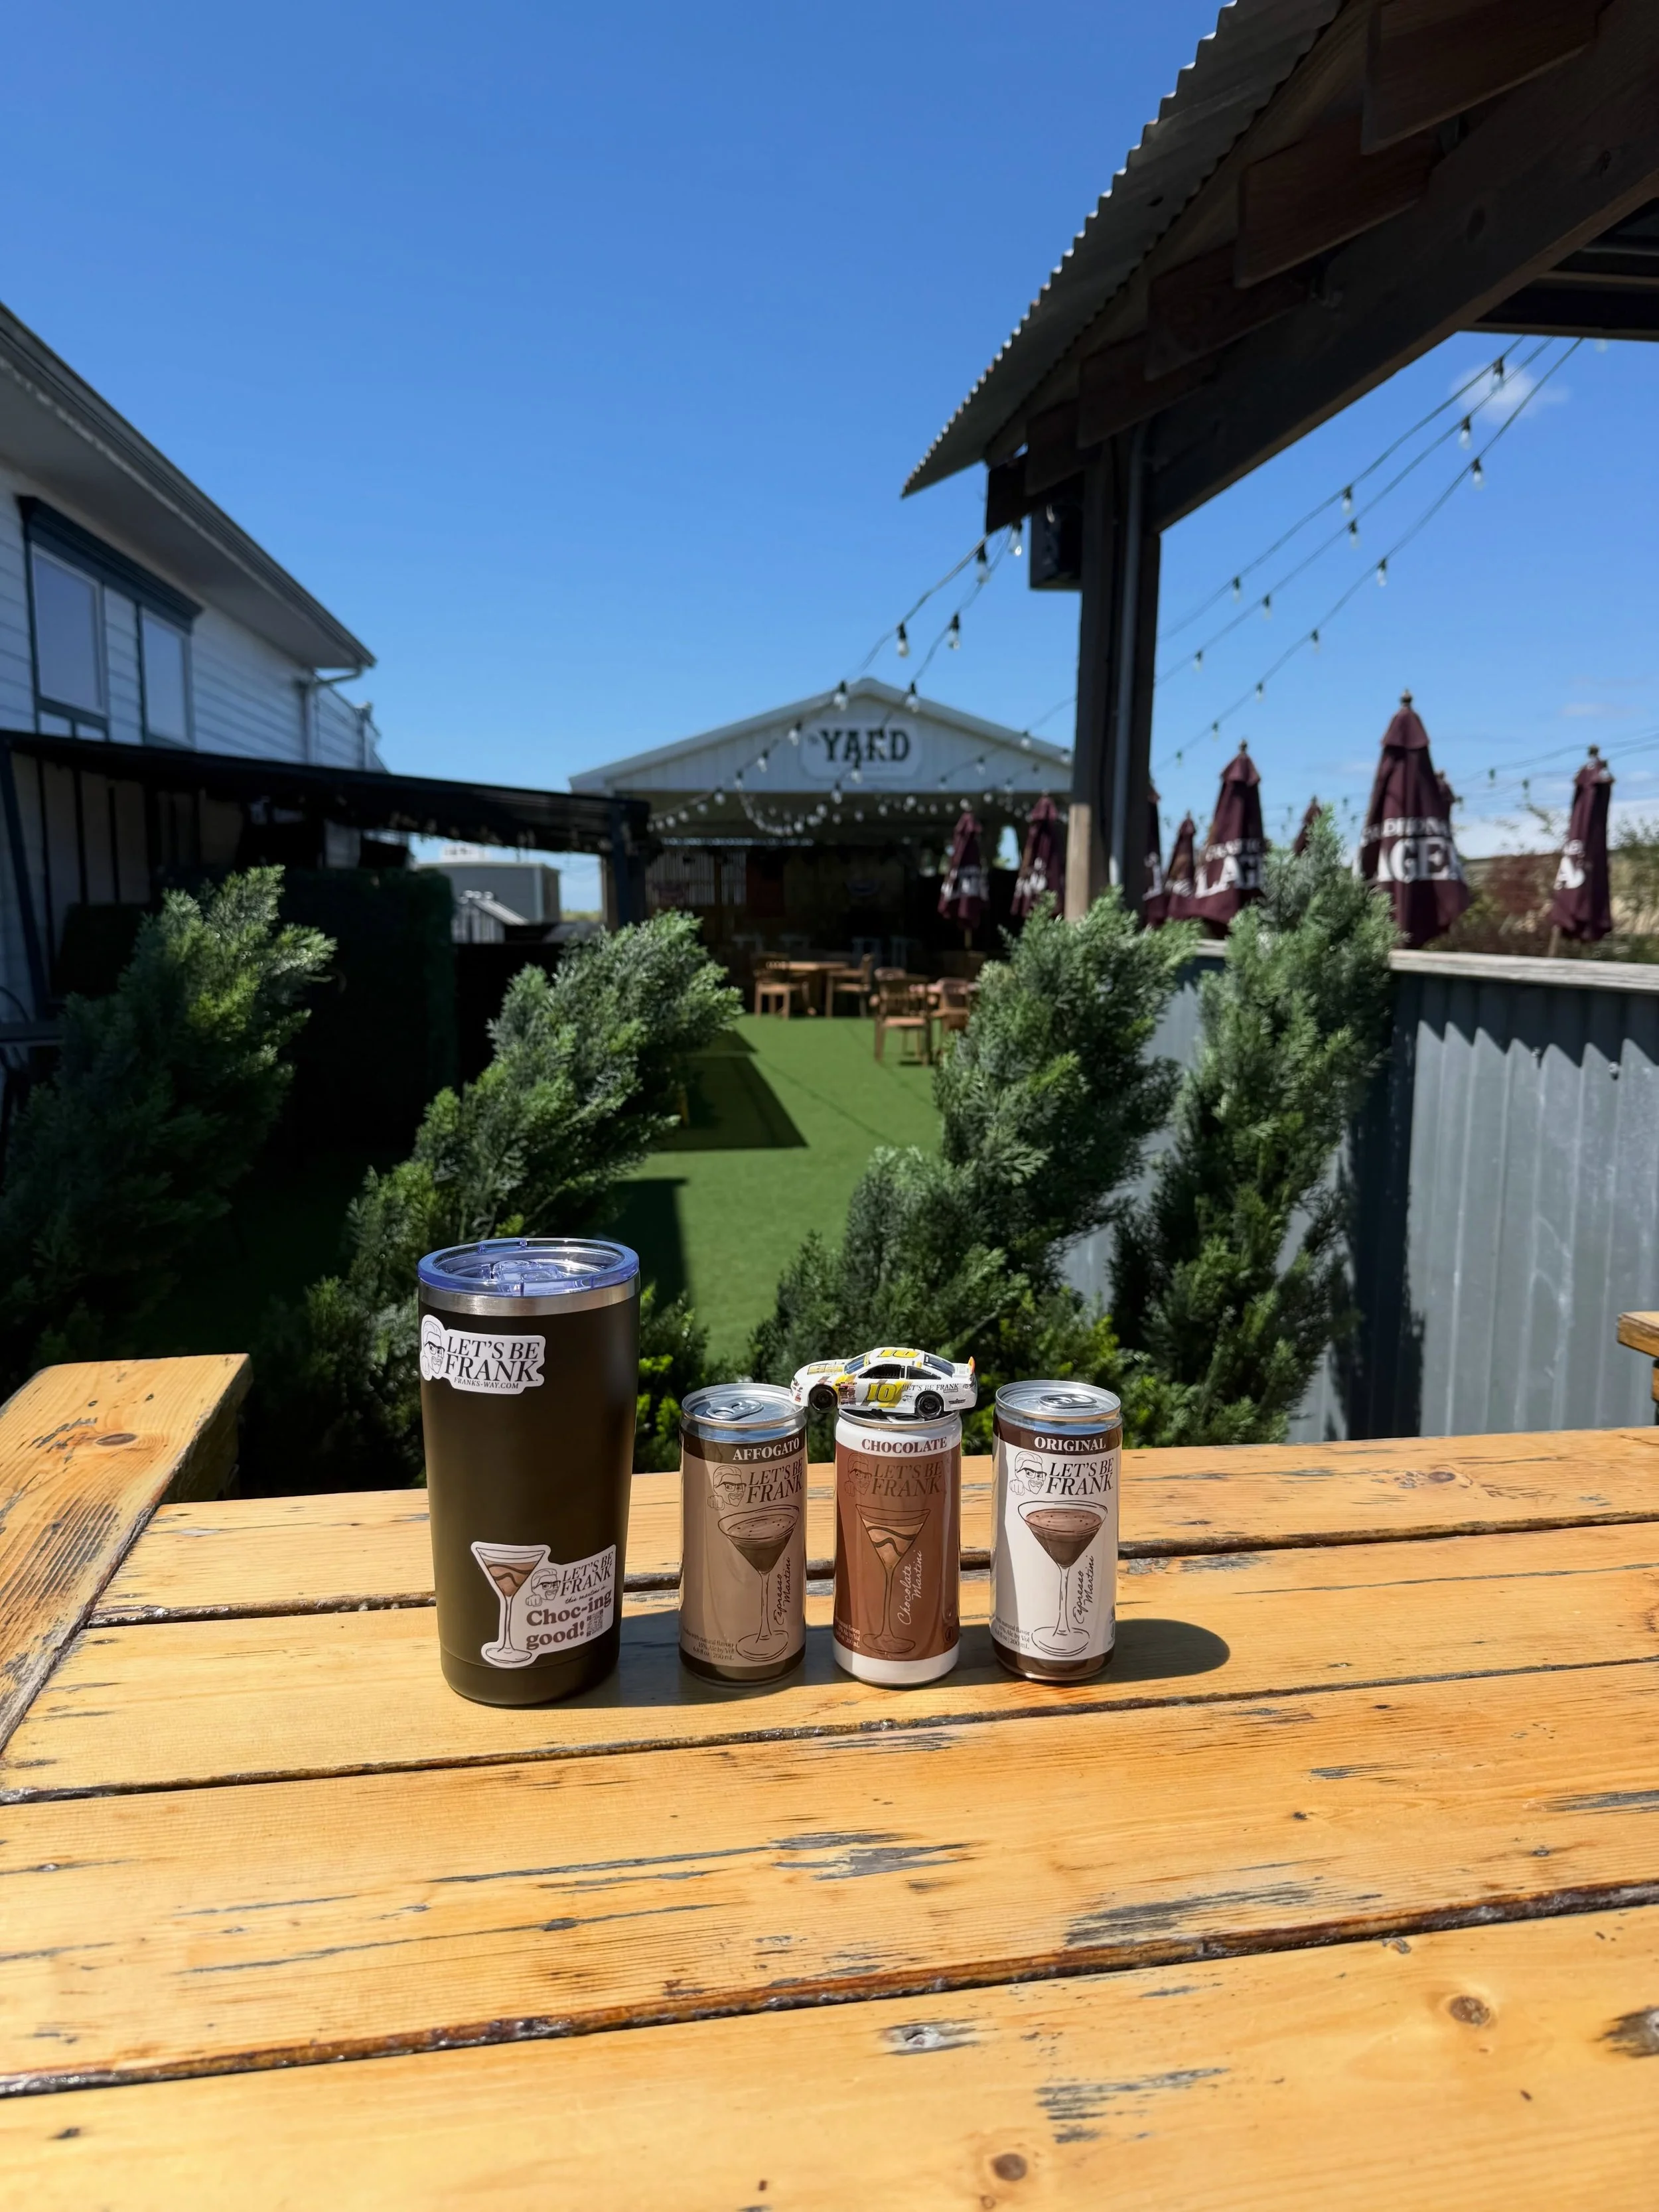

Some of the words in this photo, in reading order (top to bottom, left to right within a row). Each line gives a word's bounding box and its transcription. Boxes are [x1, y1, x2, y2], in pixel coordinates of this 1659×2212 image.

[819, 729, 910, 763] YARD
[447, 1336, 504, 1359] LET'S
[508, 1342, 540, 1360] BE
[878, 1349, 920, 1358] 10
[454, 1377, 519, 1389] FRANKS-WAY.COM
[865, 1382, 897, 1402] 10
[733, 1437, 800, 1461] AFFOGATO
[861, 1436, 948, 1453] CHOCOLATE
[1034, 1436, 1106, 1452] ORIGINAL
[749, 1463, 791, 1485] LET'S
[792, 1457, 803, 1477] BE
[875, 1463, 920, 1479] LET'S
[924, 1460, 944, 1477] BE
[1049, 1462, 1098, 1477] LET'S
[1099, 1457, 1114, 1475] BE
[746, 1472, 803, 1504] FRANK
[871, 1475, 943, 1497] FRANK
[560, 1563, 613, 1597] FRANK
[563, 1560, 599, 1582] LET'S
[601, 1552, 614, 1568] BE
[912, 1550, 923, 1601] Martini
[1083, 1555, 1094, 1605] Martini
[526, 1589, 612, 1626] Choc-ing
[774, 1574, 787, 1625] Espresso
[897, 1564, 912, 1625] Chocolate
[1073, 1570, 1088, 1624] Espresso
[526, 1621, 585, 1651] good!
